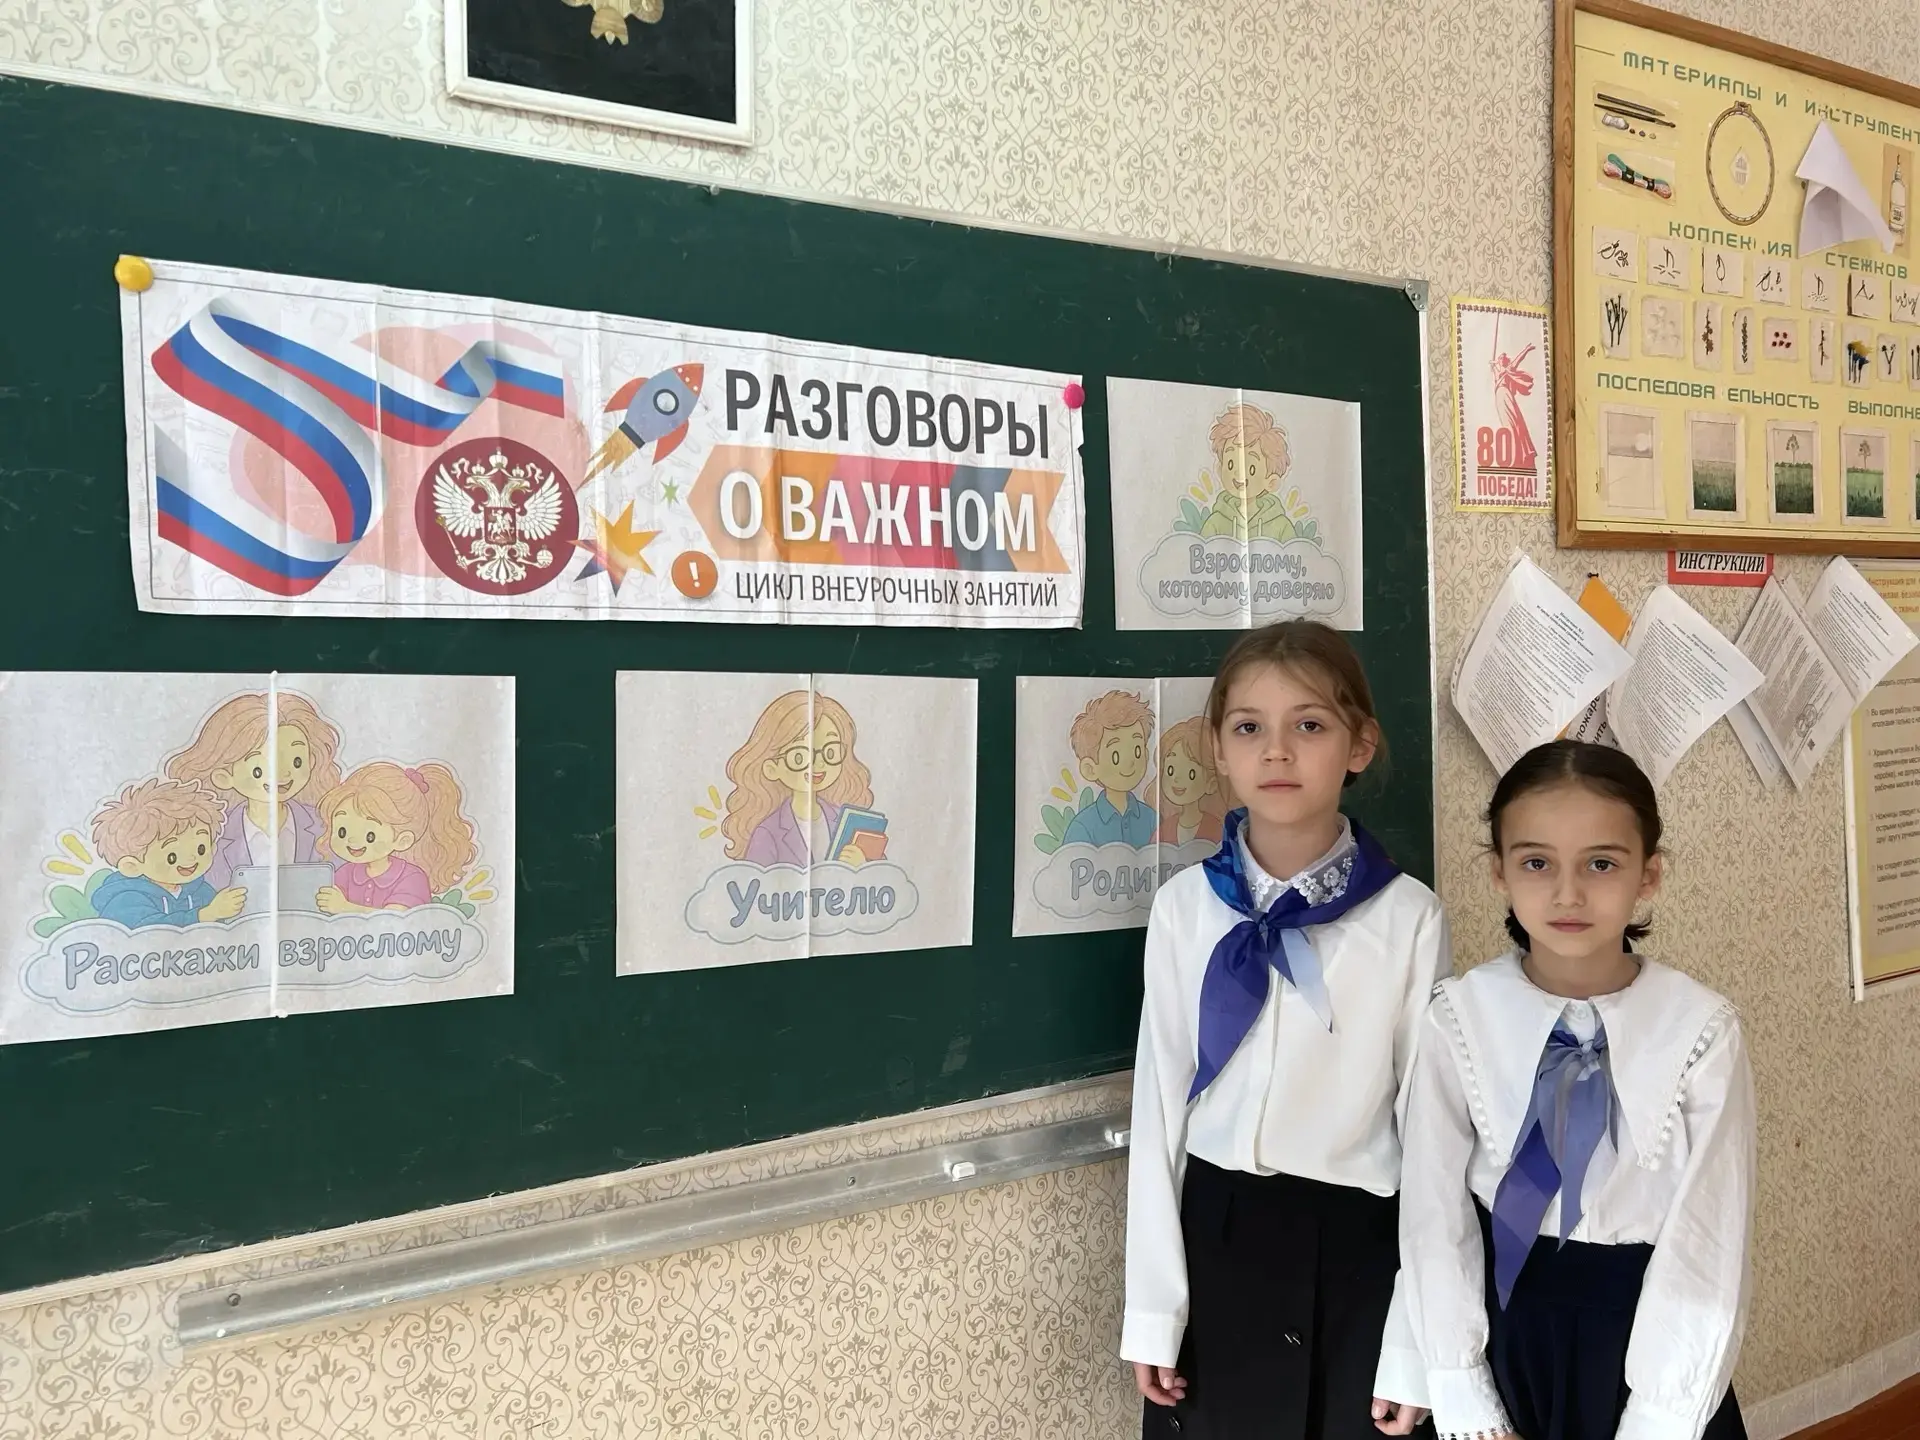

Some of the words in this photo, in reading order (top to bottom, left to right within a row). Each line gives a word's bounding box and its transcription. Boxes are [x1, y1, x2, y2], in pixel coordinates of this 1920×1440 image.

[1623, 50, 1762, 101] МАТЕРИАЛЫ
[1775, 91, 1788, 108] И
[1825, 252, 1908, 280] СТЕЖКОВ
[1597, 372, 1820, 410] ПОСЛЕДОВАЕЛЬНОСТЬ
[724, 368, 1050, 460] РАЗГОВОРЫ
[1478, 427, 1511, 466] 80
[1478, 476, 1538, 499] ПОБЕДА!
[718, 470, 764, 540] О
[780, 474, 1038, 553] ВАЖНОМ
[1188, 543, 1308, 577] Взрослому,
[1678, 552, 1766, 575] ИНСТРУКЦИИ
[735, 571, 805, 604] ЦИКЛ
[812, 574, 960, 606] ВНЕУРОЧНЫХ
[964, 577, 1058, 607] ЗАНЯТИЙ
[1158, 577, 1248, 606] которому
[1253, 579, 1336, 607] доверяю
[1575, 695, 1601, 741] пожаре
[725, 878, 897, 929] Учителю
[62, 941, 260, 990] Расскажи
[277, 927, 463, 973] взрослому
